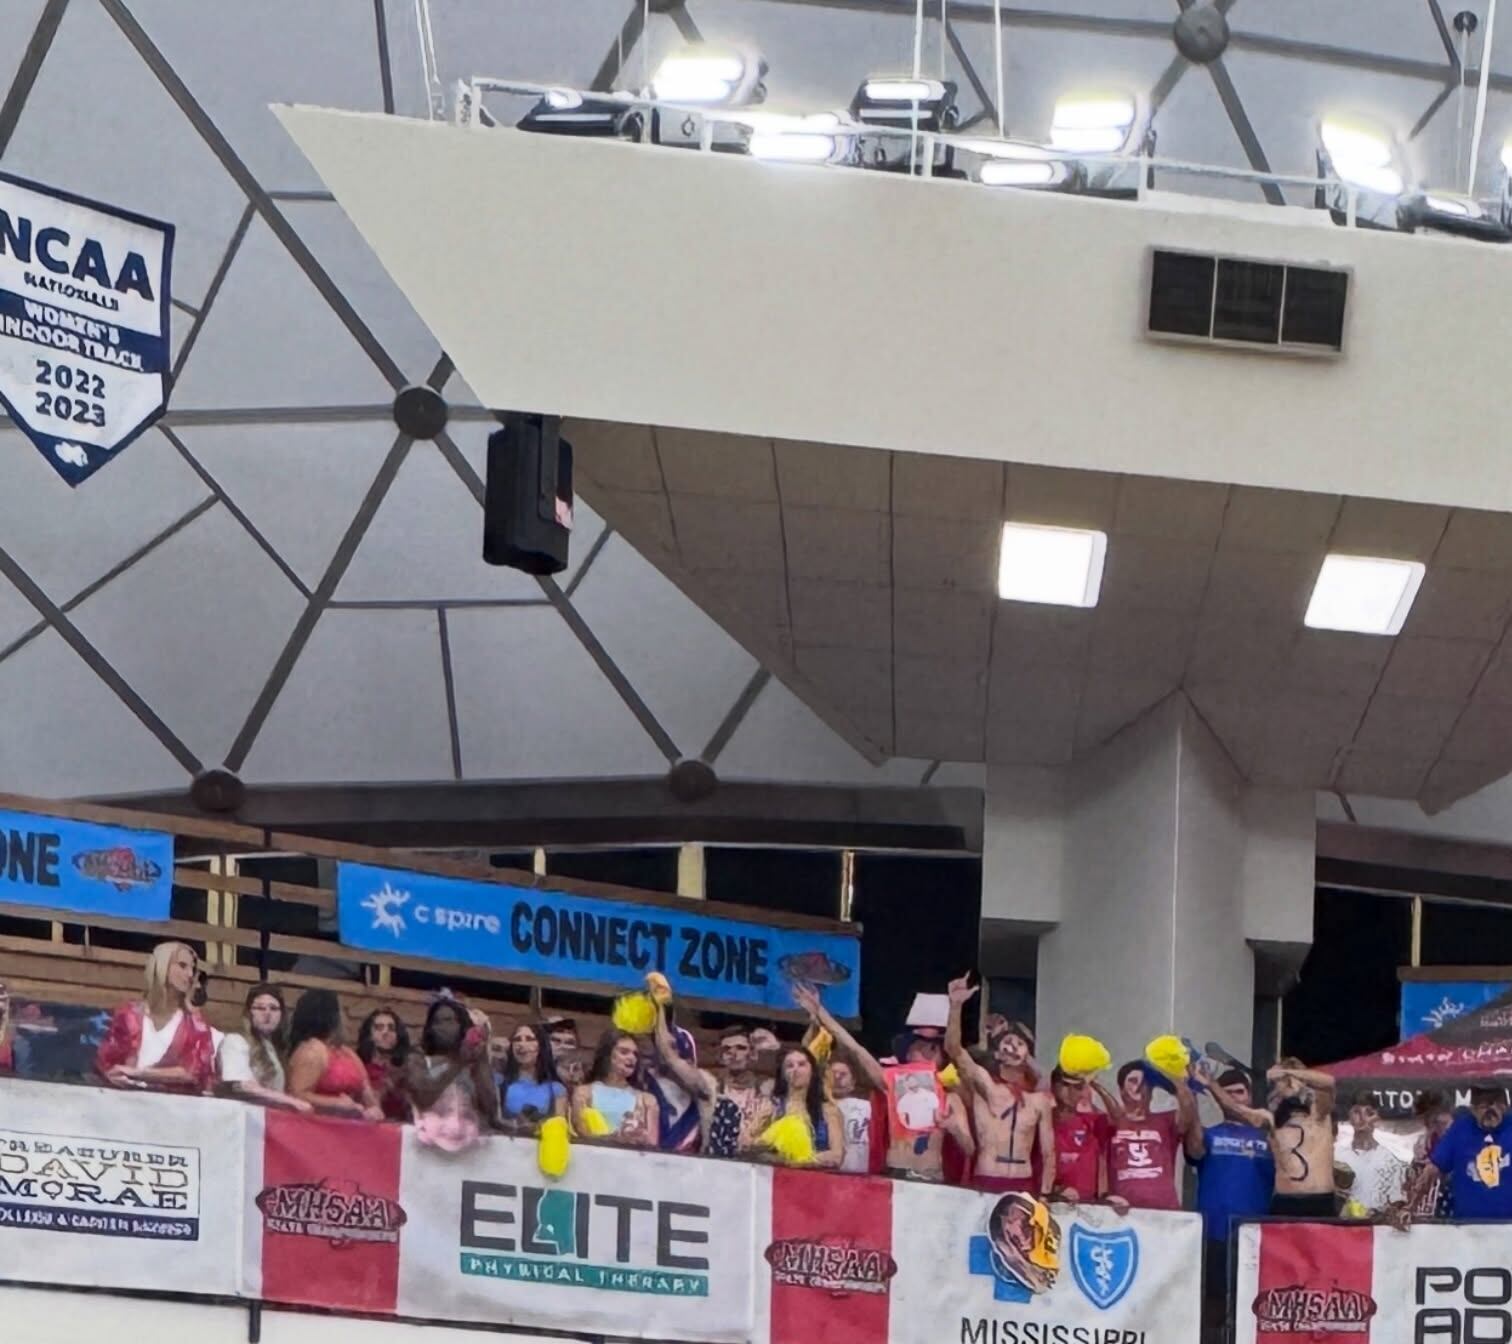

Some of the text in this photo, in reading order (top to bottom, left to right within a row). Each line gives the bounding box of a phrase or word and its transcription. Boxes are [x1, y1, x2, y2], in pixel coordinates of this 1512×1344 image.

[0, 208, 154, 301] NCAA
[36, 360, 105, 399] 2022
[36, 391, 105, 428] 2023
[434, 908, 501, 936] spire
[510, 901, 672, 971] CONNECT
[679, 927, 769, 987] ZONE
[275, 1187, 389, 1230] MHSAA
[460, 1180, 711, 1271] ELITE
[1266, 1289, 1363, 1321] MHSAA
